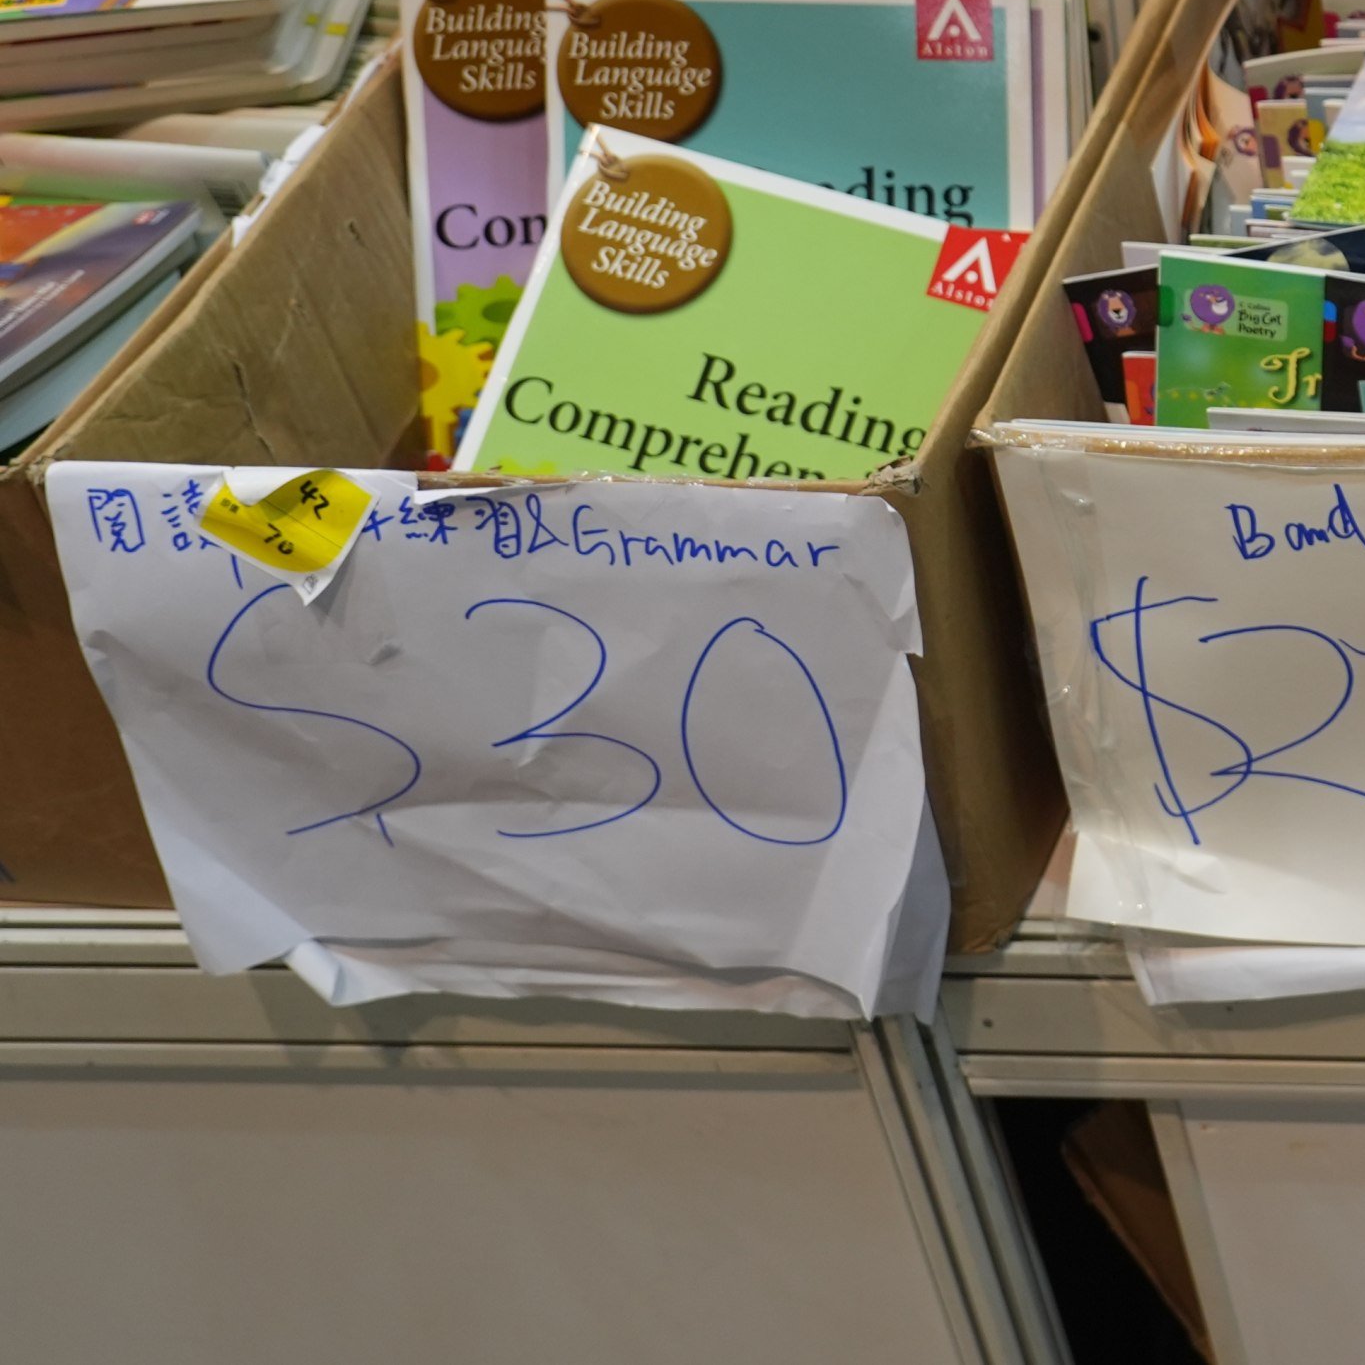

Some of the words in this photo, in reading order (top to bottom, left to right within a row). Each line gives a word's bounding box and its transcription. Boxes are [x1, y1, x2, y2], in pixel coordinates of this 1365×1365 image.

[424, 3, 547, 37] Building
[431, 33, 547, 68] Langua
[568, 31, 691, 68] Building
[921, 41, 989, 59] Alston
[459, 61, 539, 93] Skills
[573, 59, 713, 96] Language
[600, 90, 677, 121] Skills
[581, 178, 709, 243] Building
[816, 165, 975, 228] ding
[576, 206, 718, 270] Language
[589, 244, 670, 291] Skills
[1237, 323, 1278, 340] Poetry
[1238, 309, 1261, 327] Big
[1262, 312, 1284, 328] Cat
[685, 352, 928, 457] Reading
[298, 479, 332, 521] 42
[207, 552, 848, 847] $30
